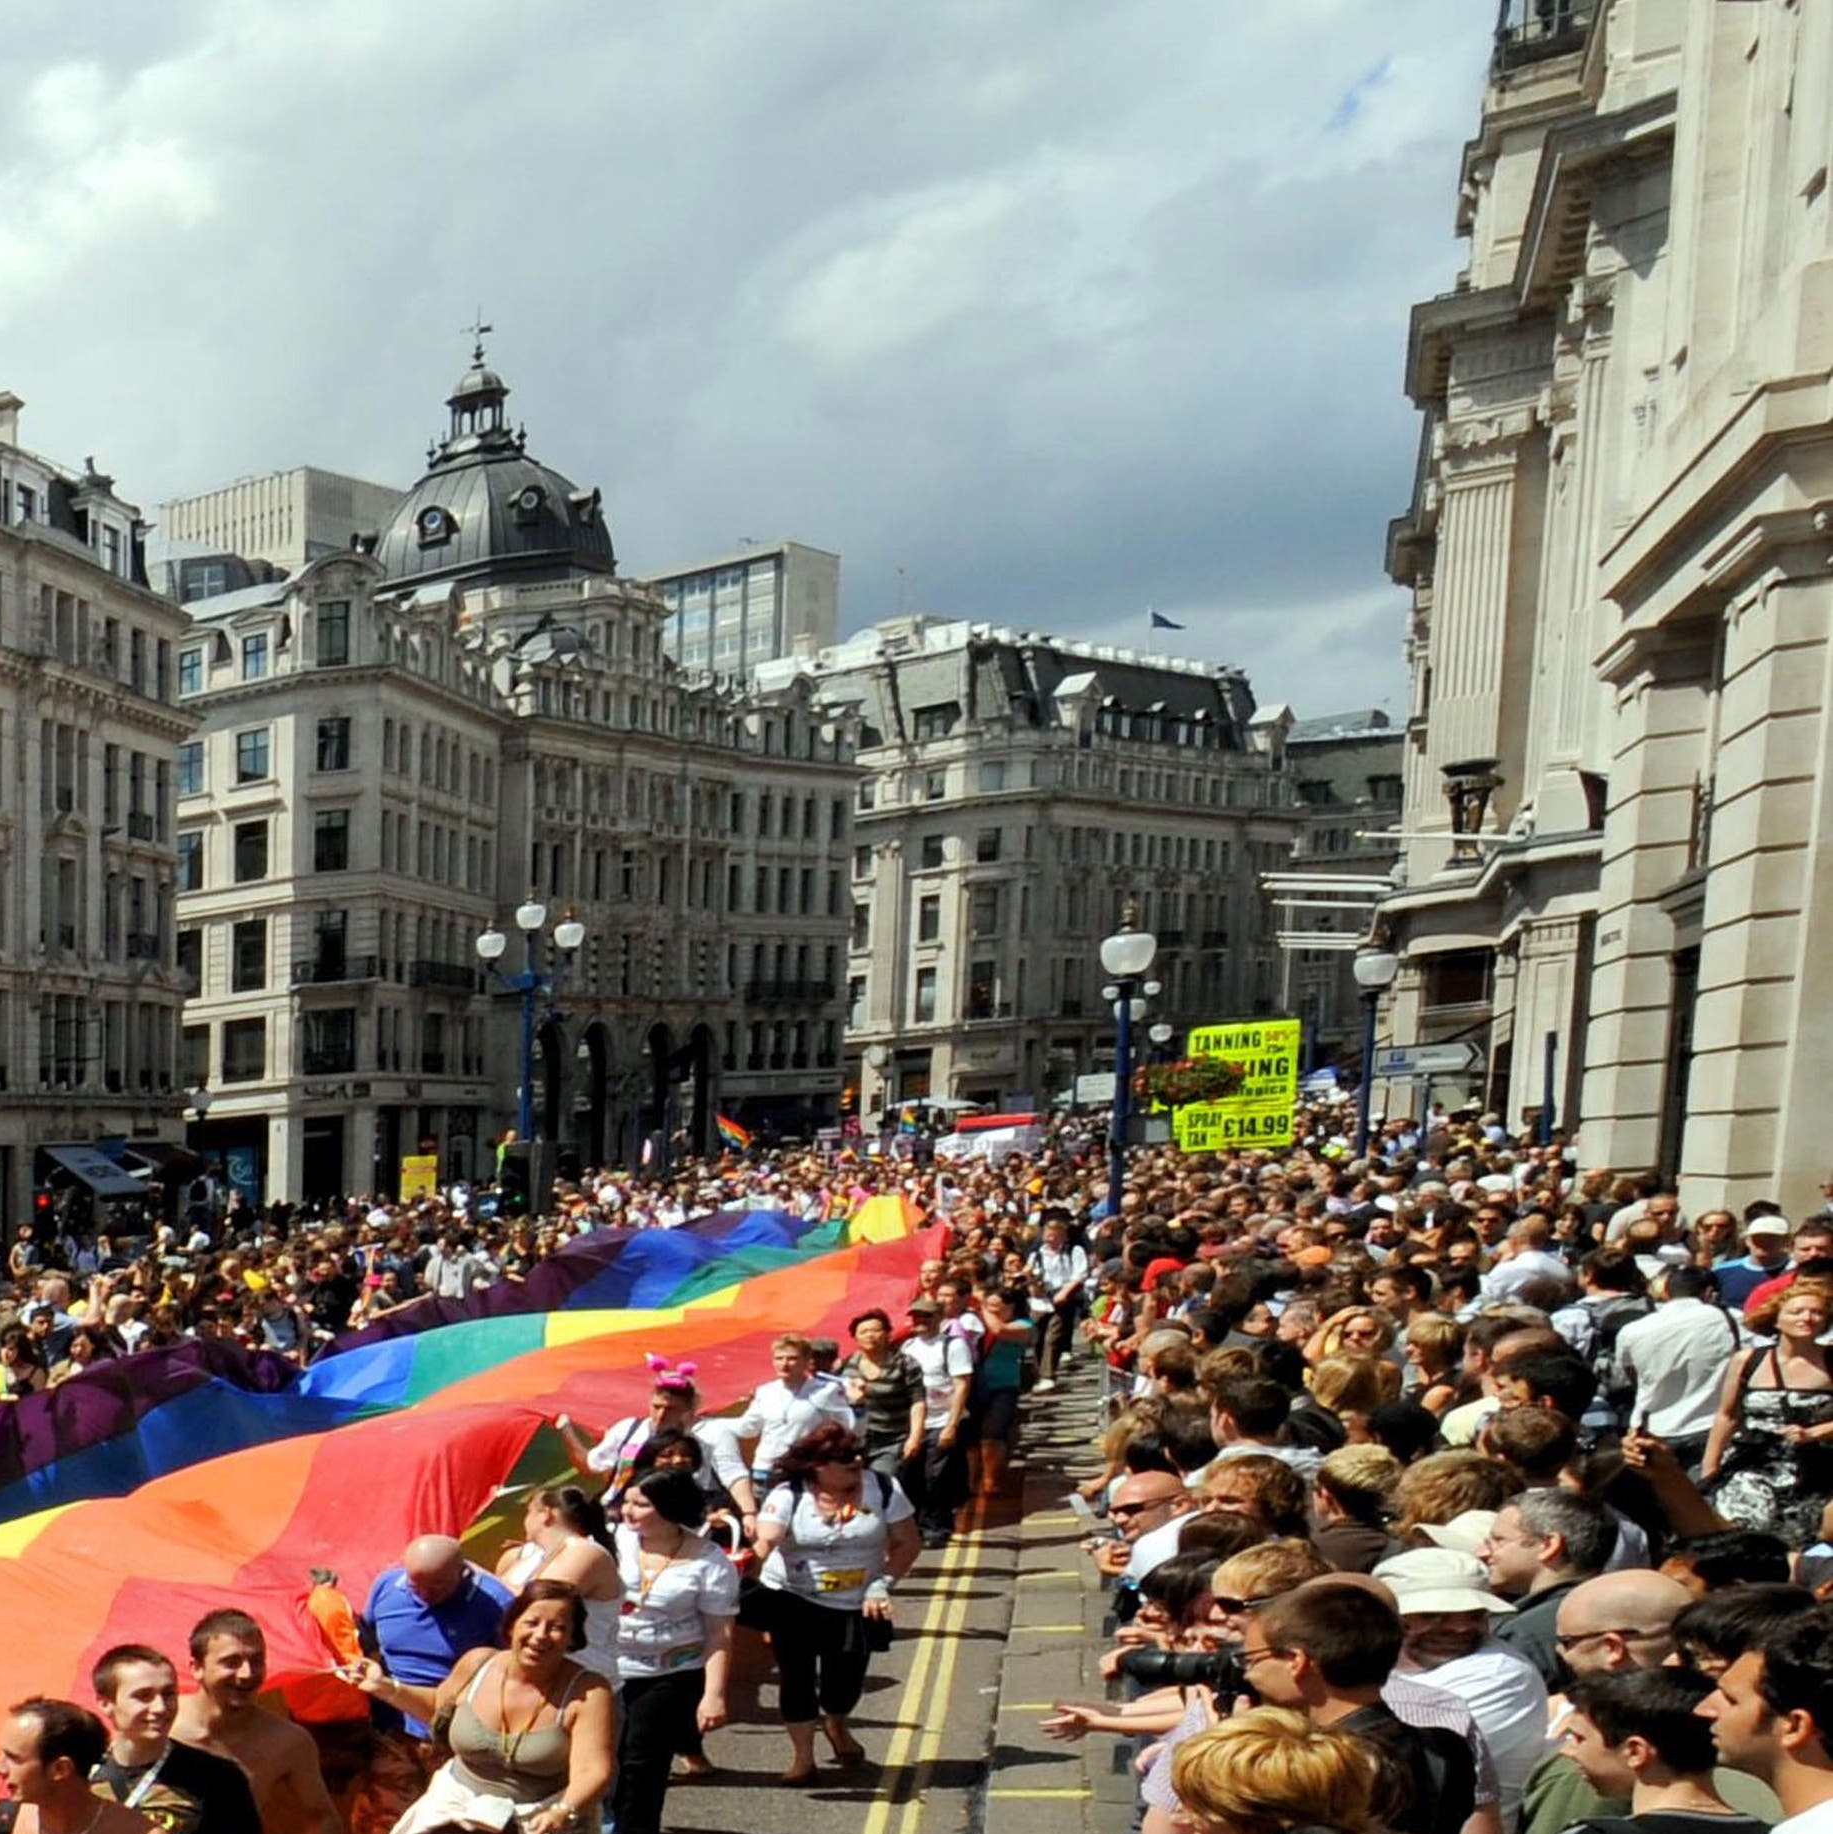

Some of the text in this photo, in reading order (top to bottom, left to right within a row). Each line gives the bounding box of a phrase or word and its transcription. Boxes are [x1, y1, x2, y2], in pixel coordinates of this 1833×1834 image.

[1194, 1031, 1261, 1051] TANNING
[1188, 1112, 1289, 1137] SPRAY £14.99
